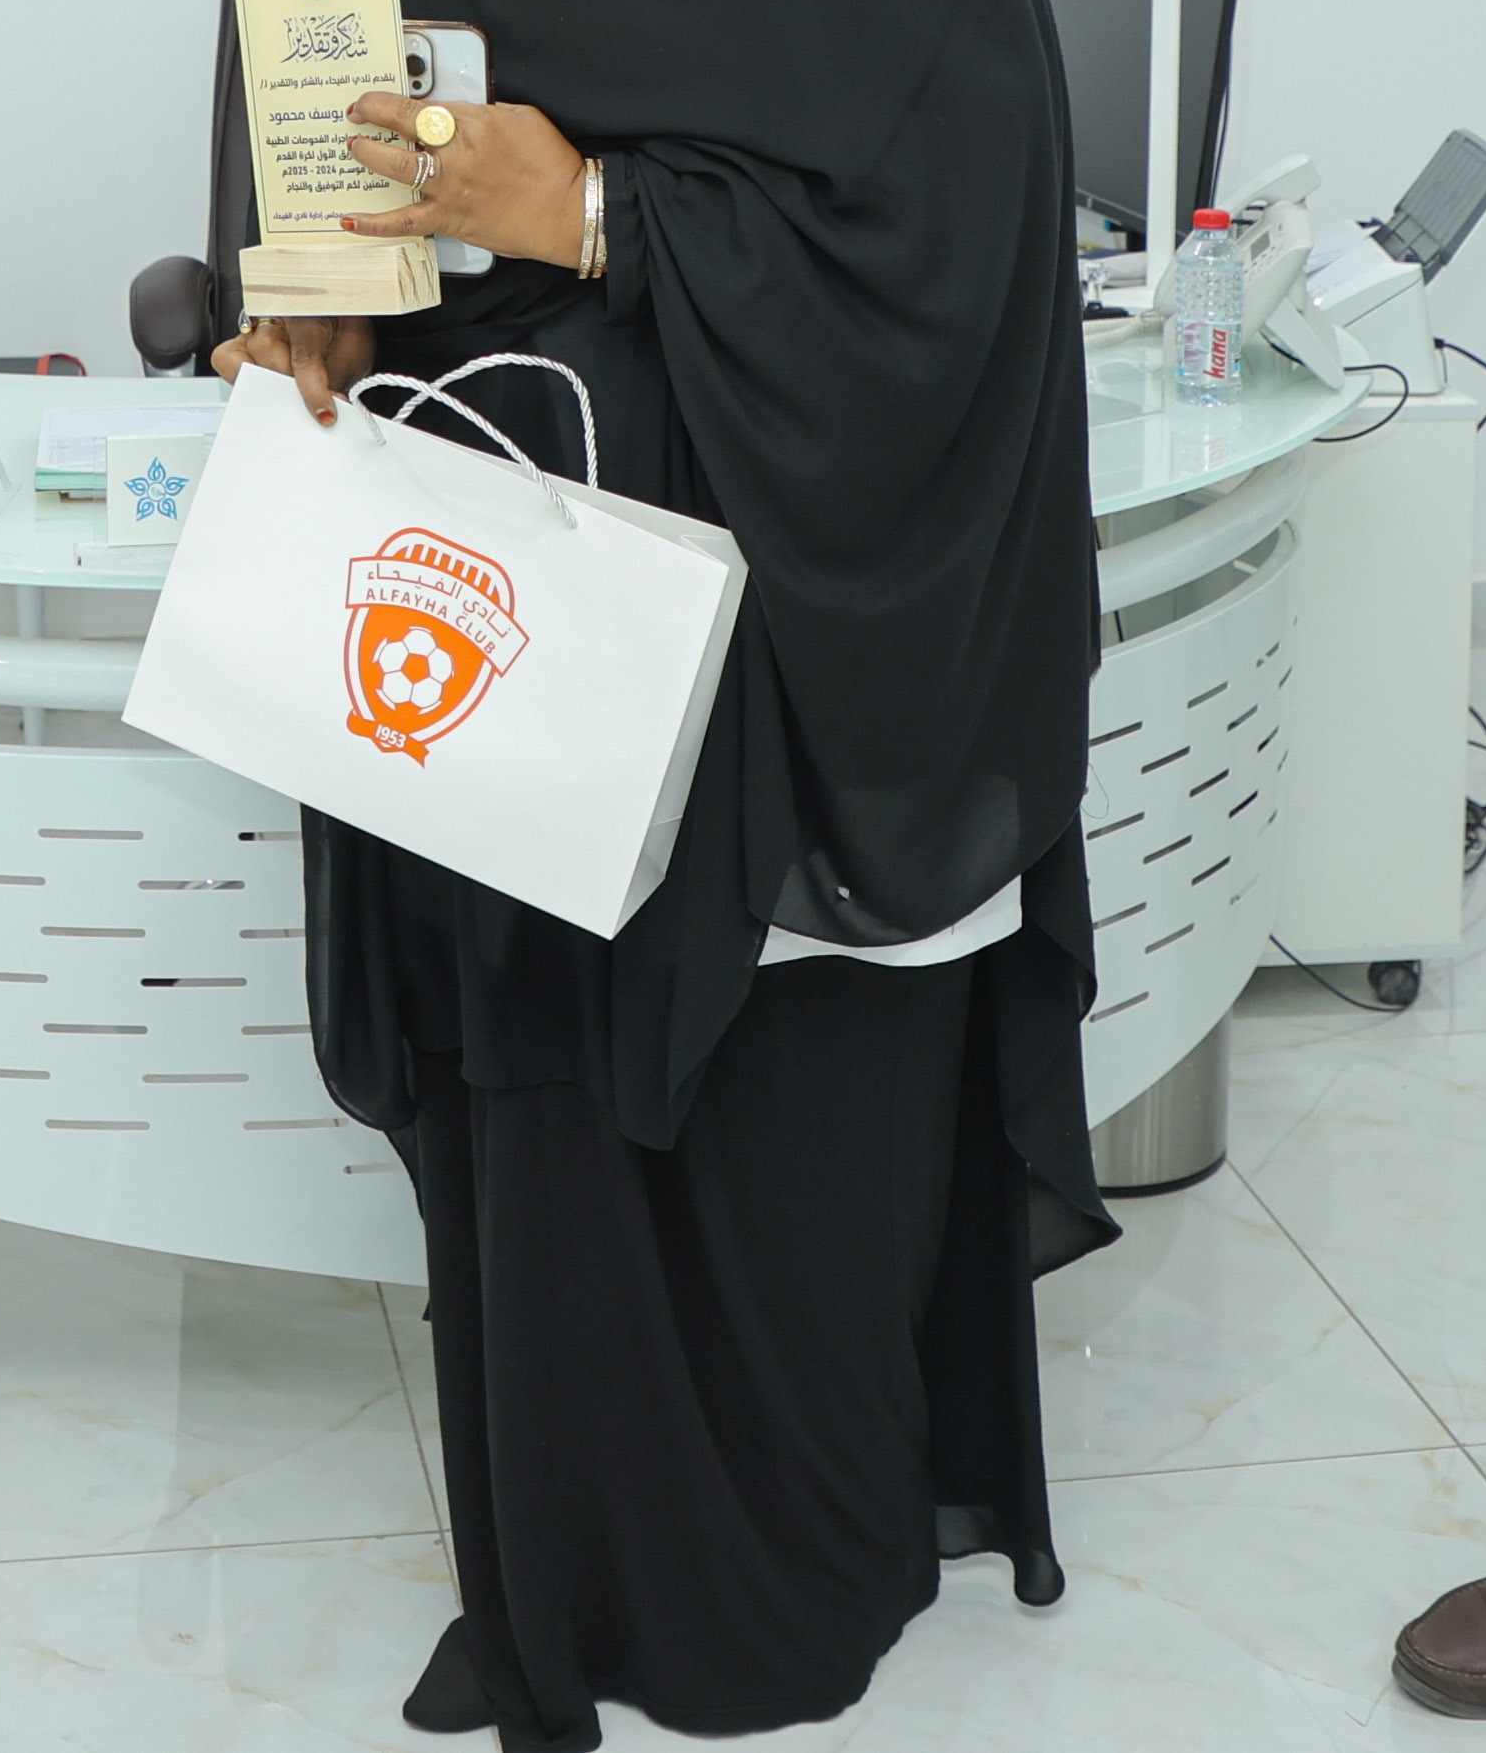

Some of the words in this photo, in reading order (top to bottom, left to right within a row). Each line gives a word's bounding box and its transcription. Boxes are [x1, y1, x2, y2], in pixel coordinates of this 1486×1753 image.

[352, 74, 371, 85] نادي
[269, 111, 306, 125] محمود
[309, 107, 344, 123] يوسف
[383, 131, 400, 143] على
[316, 165, 337, 174] 2024
[346, 180, 361, 191] لكم
[1203, 328, 1227, 379] hana
[367, 563, 463, 599] الفيحاء
[366, 588, 448, 618] ALFAYHA
[455, 614, 496, 654] CLUB
[463, 599, 511, 638] نادي
[375, 724, 407, 748] 1953
